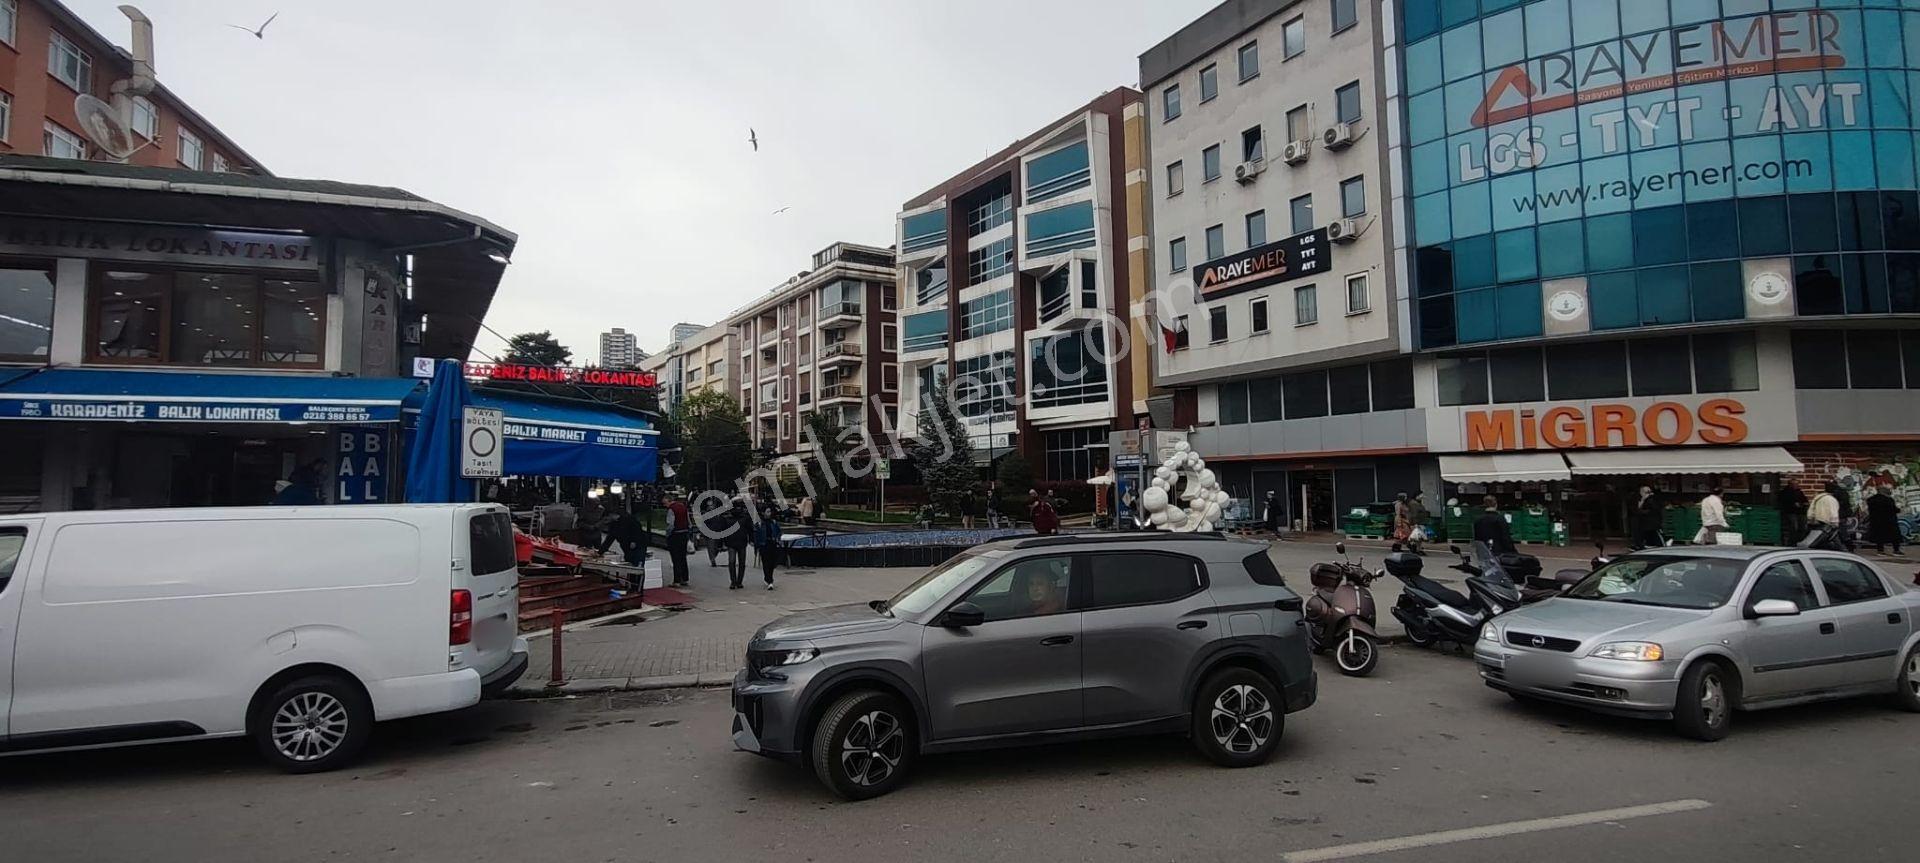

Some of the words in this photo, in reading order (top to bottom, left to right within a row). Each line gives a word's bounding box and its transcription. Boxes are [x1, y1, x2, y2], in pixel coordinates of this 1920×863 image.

[1458, 126, 1547, 182] LGS
[1591, 97, 1702, 154] TYT
[1757, 82, 1863, 132] AYT
[1513, 158, 1813, 213] www.rayemer.com
[126, 236, 312, 261] LOKANTASI
[1300, 235, 1316, 246] LGS
[1301, 248, 1316, 258] TYT
[1302, 260, 1316, 271] AYT
[51, 402, 145, 418] KARADENİZ
[158, 405, 202, 419] BALIK
[205, 406, 281, 421] LOKANTASI
[303, 412, 326, 420] 0216
[503, 424, 539, 437] BALIK
[541, 427, 587, 441] MARKET
